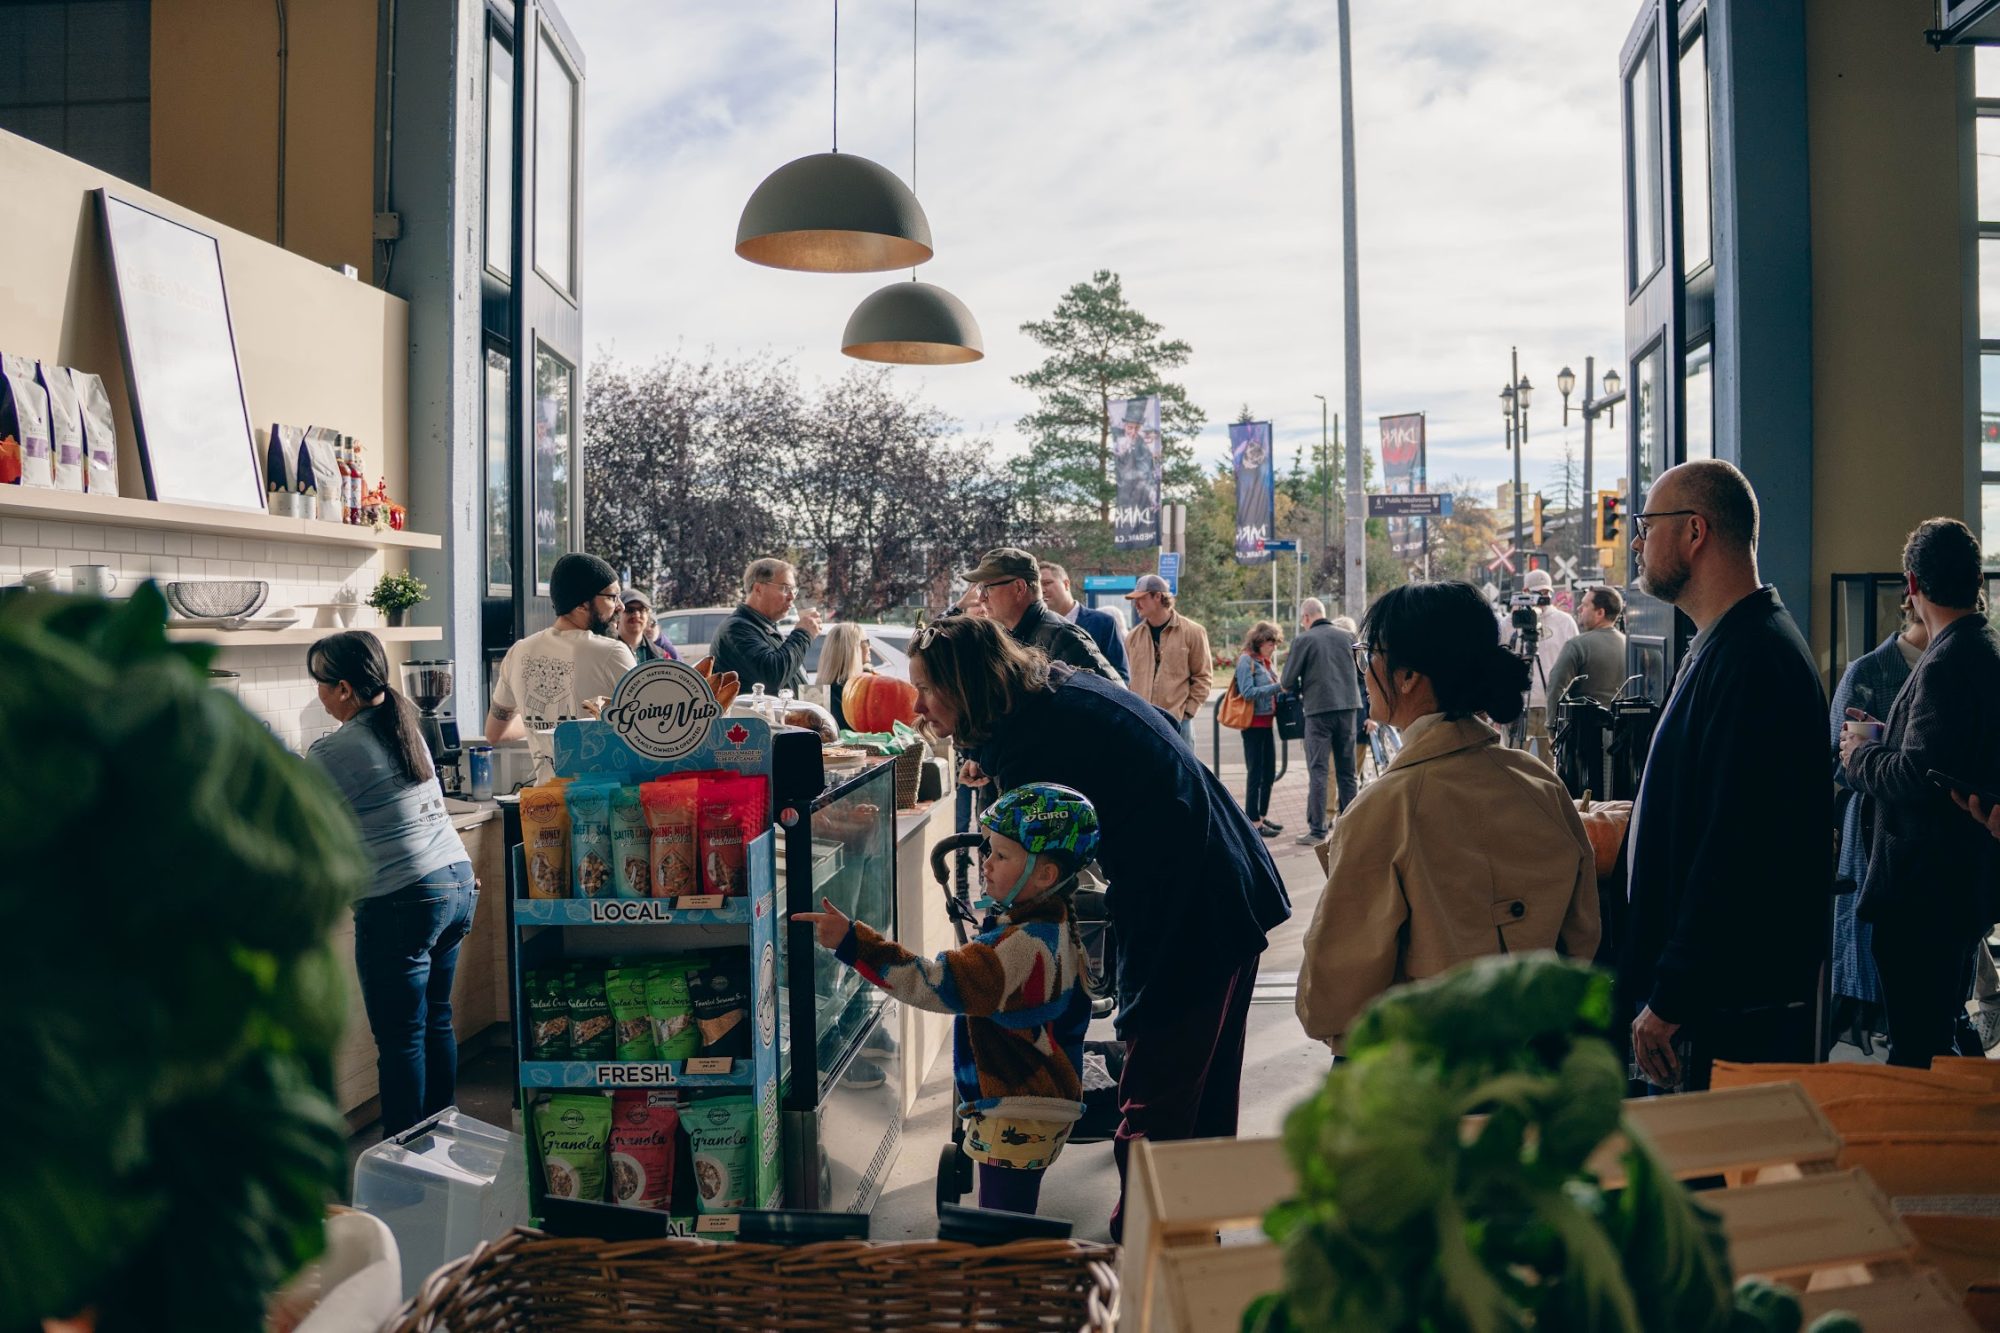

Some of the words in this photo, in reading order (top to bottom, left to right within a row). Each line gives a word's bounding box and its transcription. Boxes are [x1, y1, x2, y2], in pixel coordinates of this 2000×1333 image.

[626, 679, 641, 697] FRESH
[646, 670, 672, 678] NATURAL
[678, 674, 700, 694] QUALITY
[607, 699, 674, 734] Going
[658, 697, 717, 734] Nuts
[634, 735, 652, 750] FAMILY
[679, 726, 702, 750] OPERATED
[1037, 810, 1069, 821] GIRO
[540, 829, 561, 840] HONEY
[593, 901, 669, 921] LOCAL.
[530, 998, 551, 1008] Salad
[568, 998, 589, 1008] Salad
[598, 1065, 676, 1083] FRESH.
[542, 1130, 601, 1155] Granola
[609, 1127, 666, 1155] Granola
[691, 1128, 747, 1152] Granola
